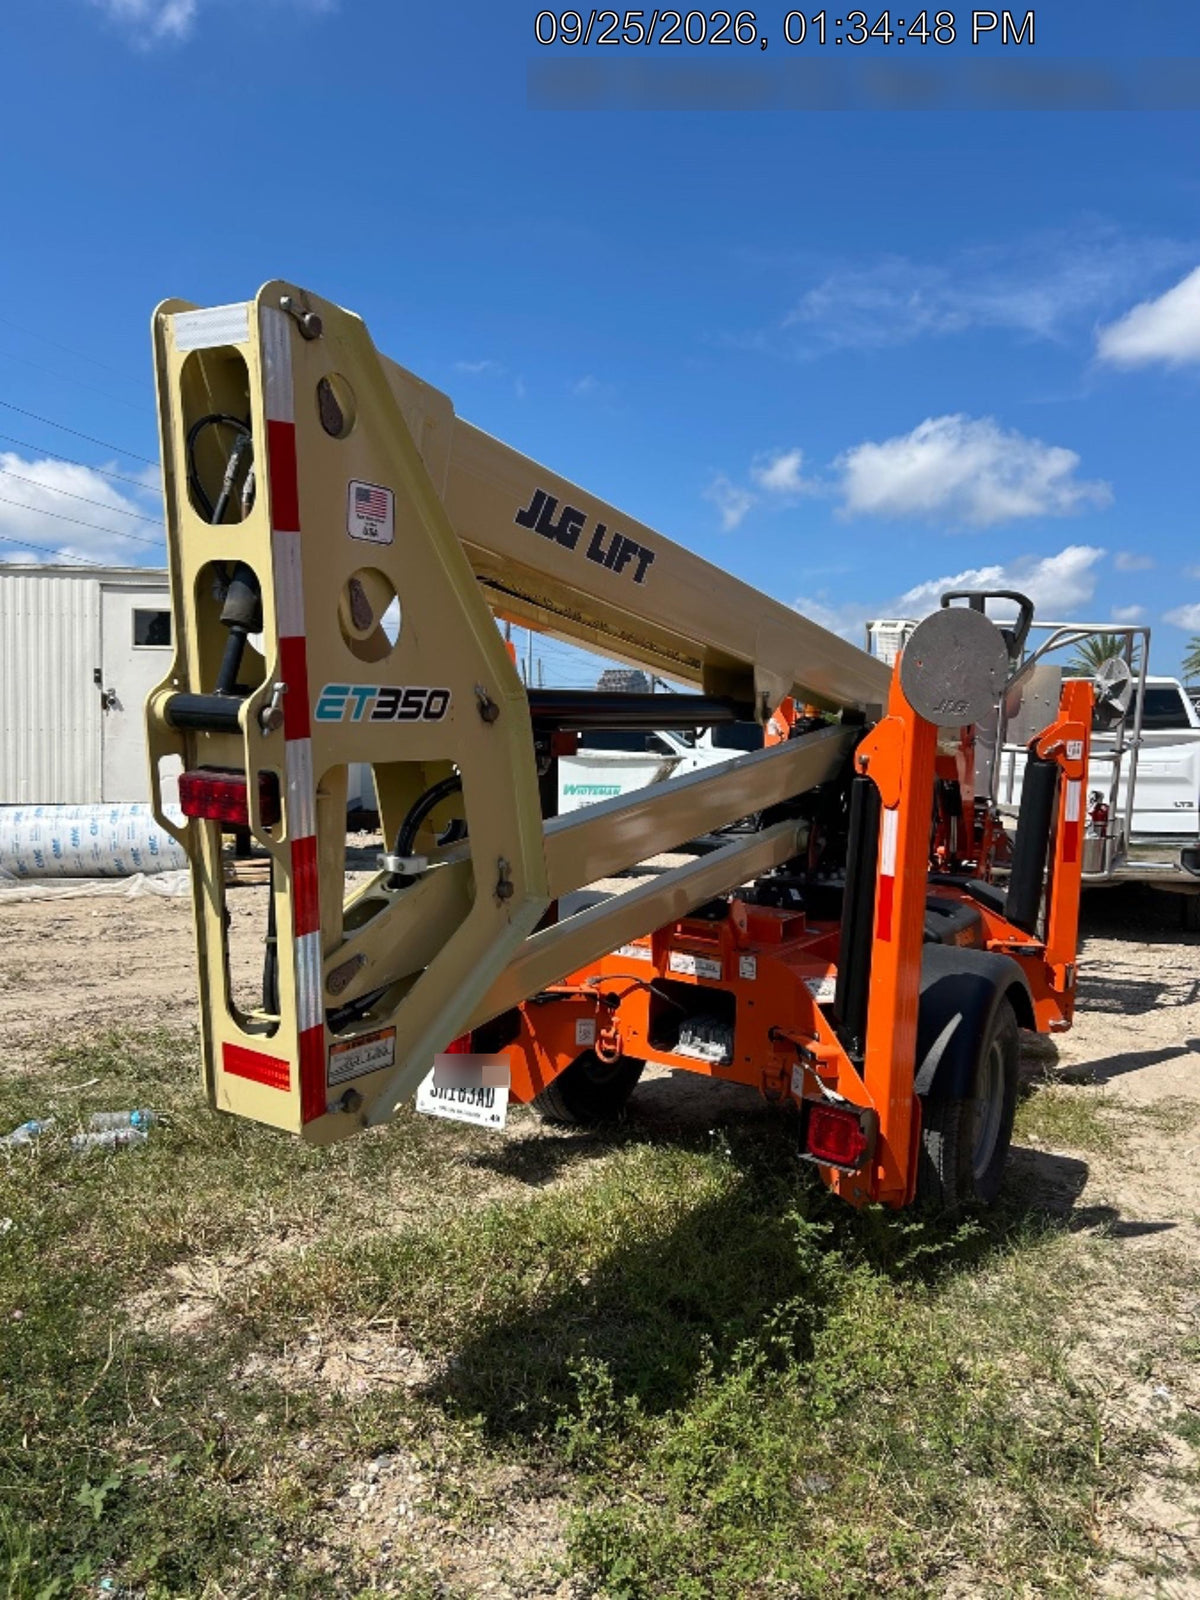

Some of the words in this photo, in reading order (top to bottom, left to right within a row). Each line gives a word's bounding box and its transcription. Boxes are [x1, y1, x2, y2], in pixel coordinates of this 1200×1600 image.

[514, 487, 587, 551] JLG
[585, 521, 657, 586] LIFT
[314, 683, 452, 722] ET350
